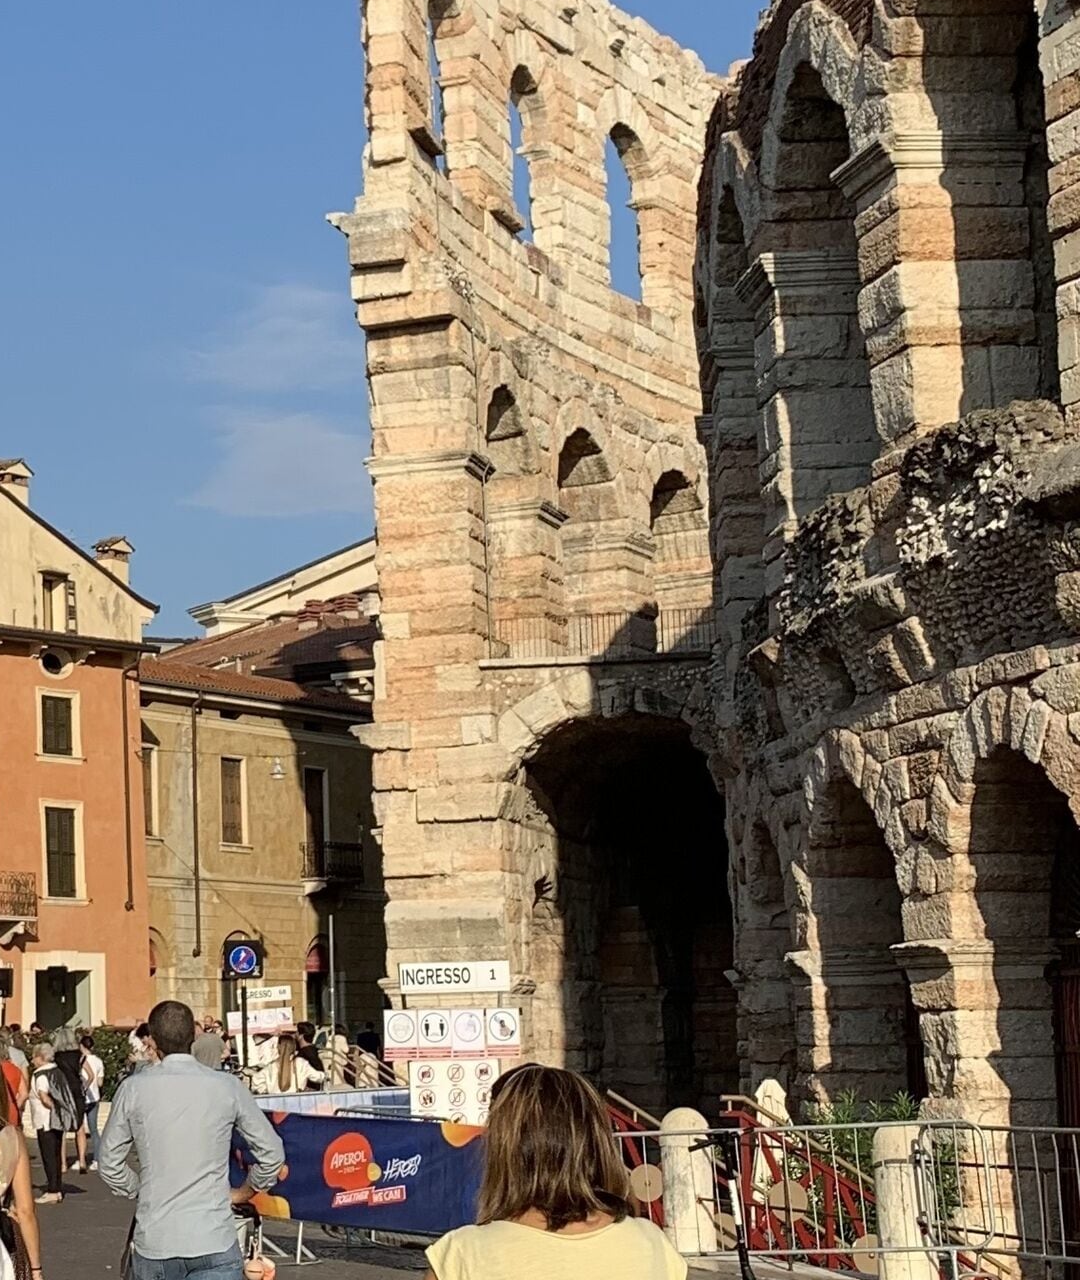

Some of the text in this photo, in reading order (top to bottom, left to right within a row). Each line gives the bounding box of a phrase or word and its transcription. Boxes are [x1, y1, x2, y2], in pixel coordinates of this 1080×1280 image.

[402, 967, 496, 986] INGRESSO 1
[238, 989, 273, 1001] IRESSO
[330, 1150, 367, 1169] APEROL
[383, 1188, 401, 1201] CAN
